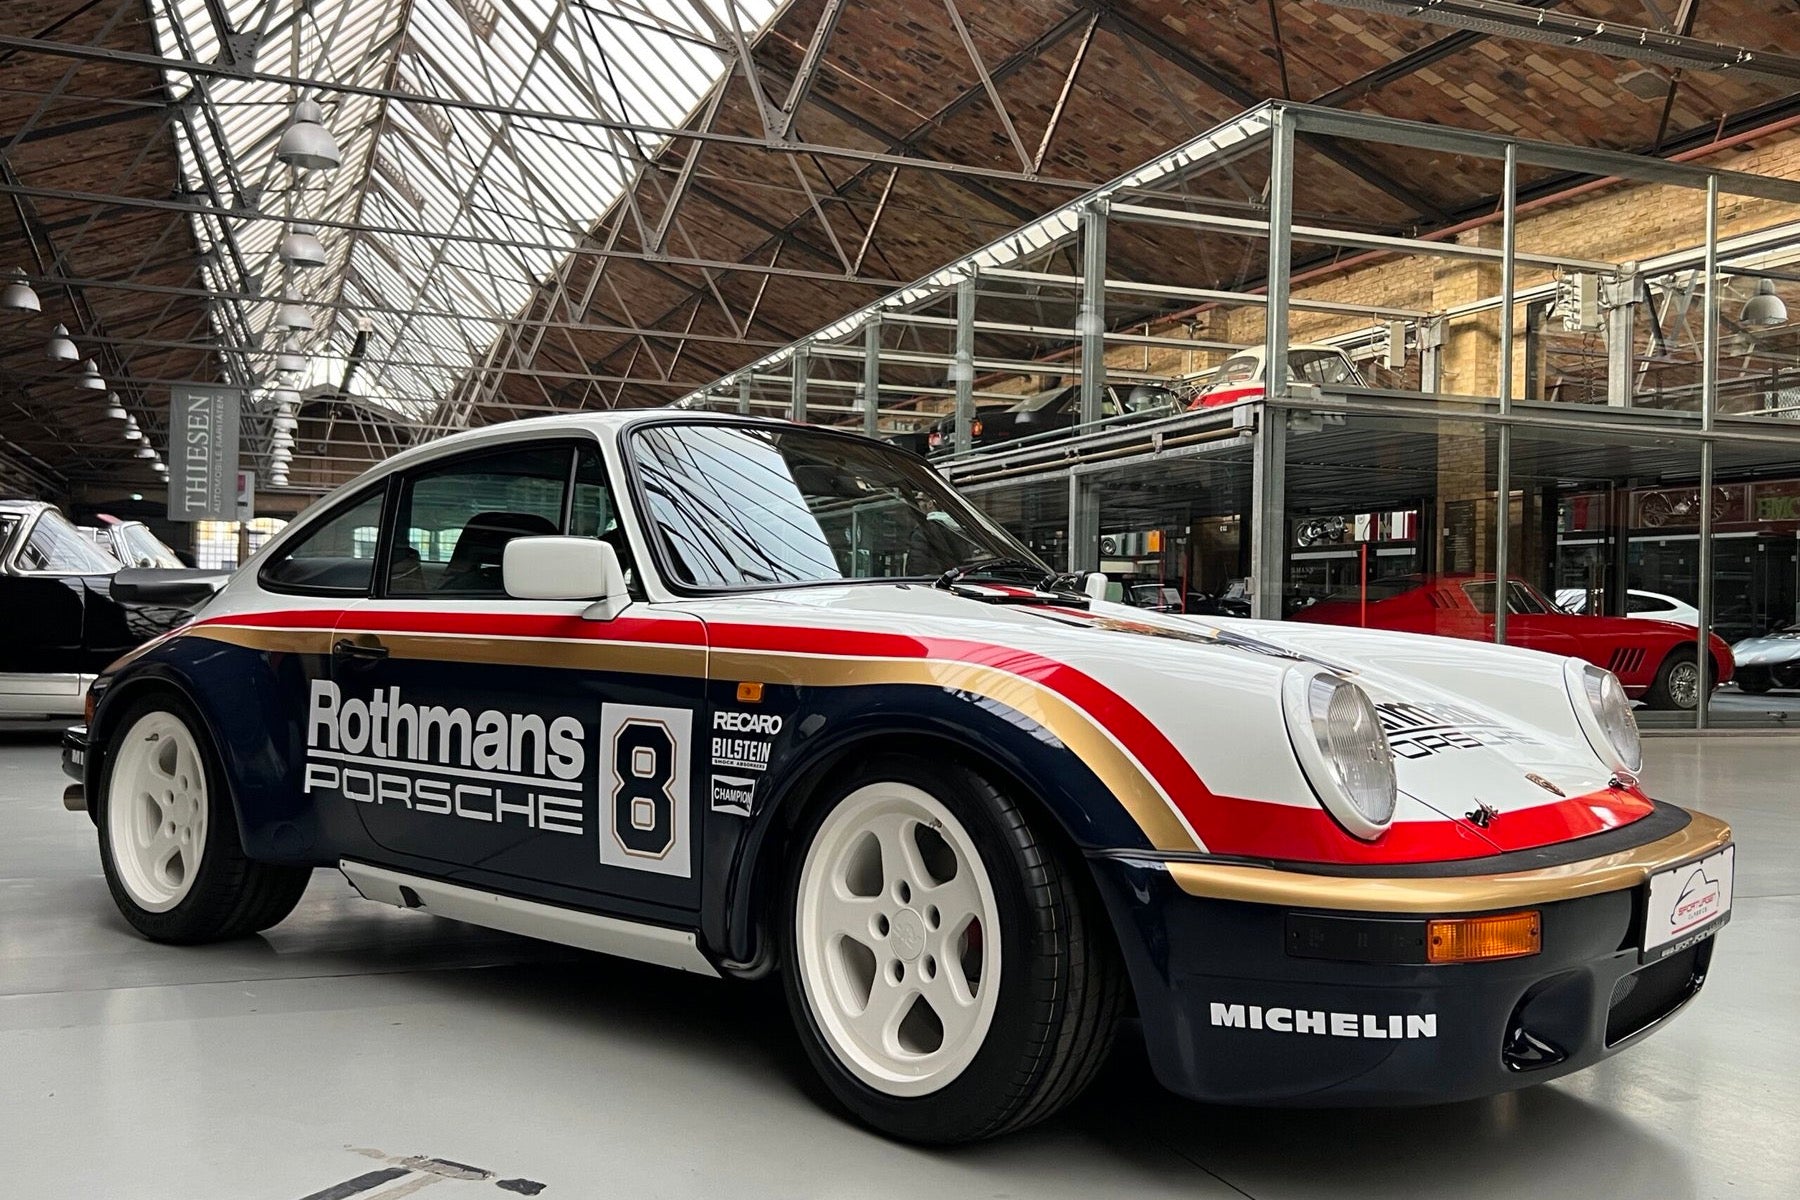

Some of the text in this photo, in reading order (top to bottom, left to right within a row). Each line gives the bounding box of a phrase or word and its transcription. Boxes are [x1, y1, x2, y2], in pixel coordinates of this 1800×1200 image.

[185, 394, 210, 512] THIESEN
[307, 678, 585, 780] Rothmans
[712, 737, 771, 763] BILSTEIN
[713, 711, 783, 735] RECARO
[304, 762, 584, 835] PORSCHE
[611, 717, 677, 861] 8
[713, 787, 753, 806] CHAMPION
[1209, 1002, 1437, 1039] MICHELIN
